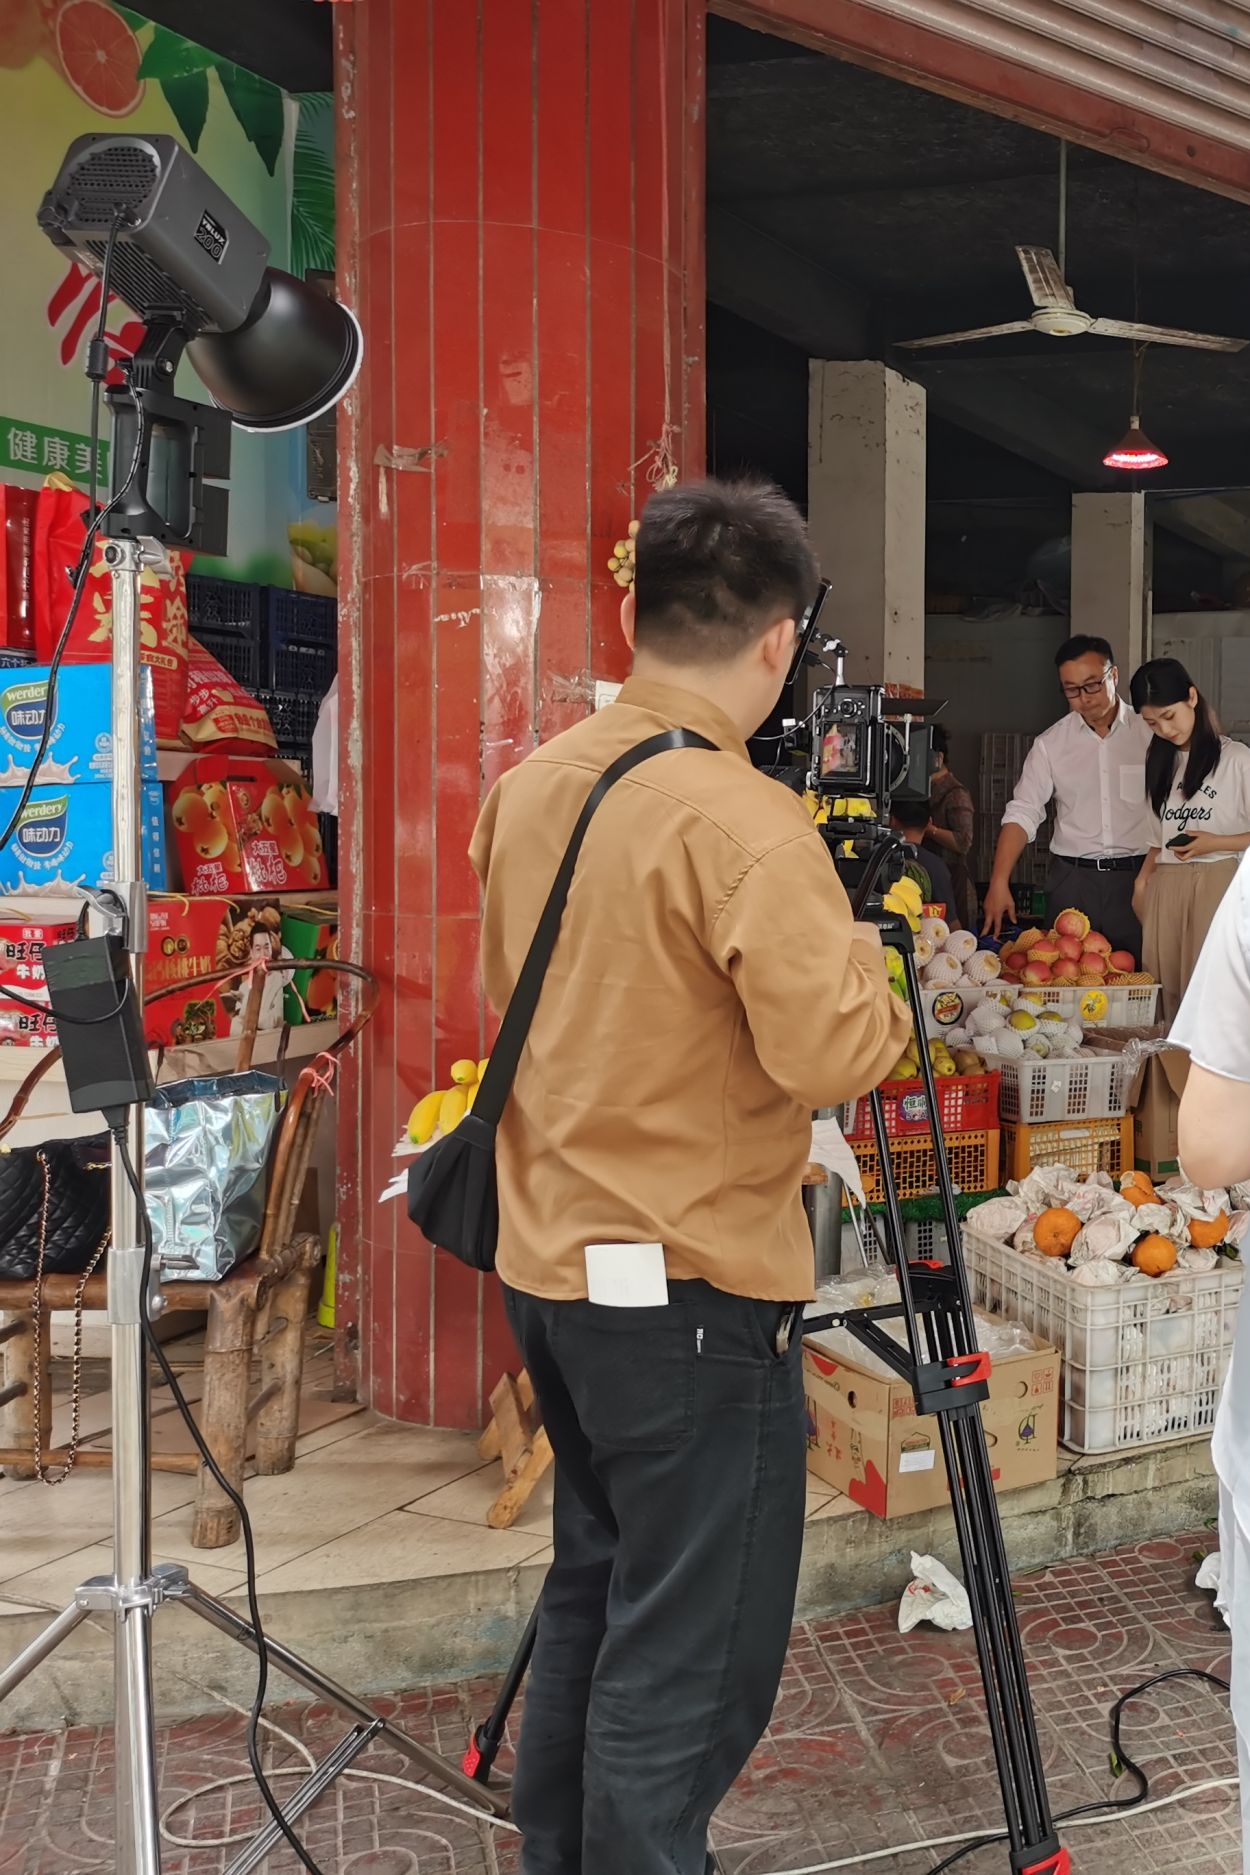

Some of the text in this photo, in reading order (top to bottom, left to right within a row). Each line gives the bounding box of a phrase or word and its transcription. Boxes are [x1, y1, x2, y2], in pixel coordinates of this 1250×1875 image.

[7, 427, 110, 478] 健康美
[7, 686, 50, 700] werder
[22, 827, 61, 843] 味动力
